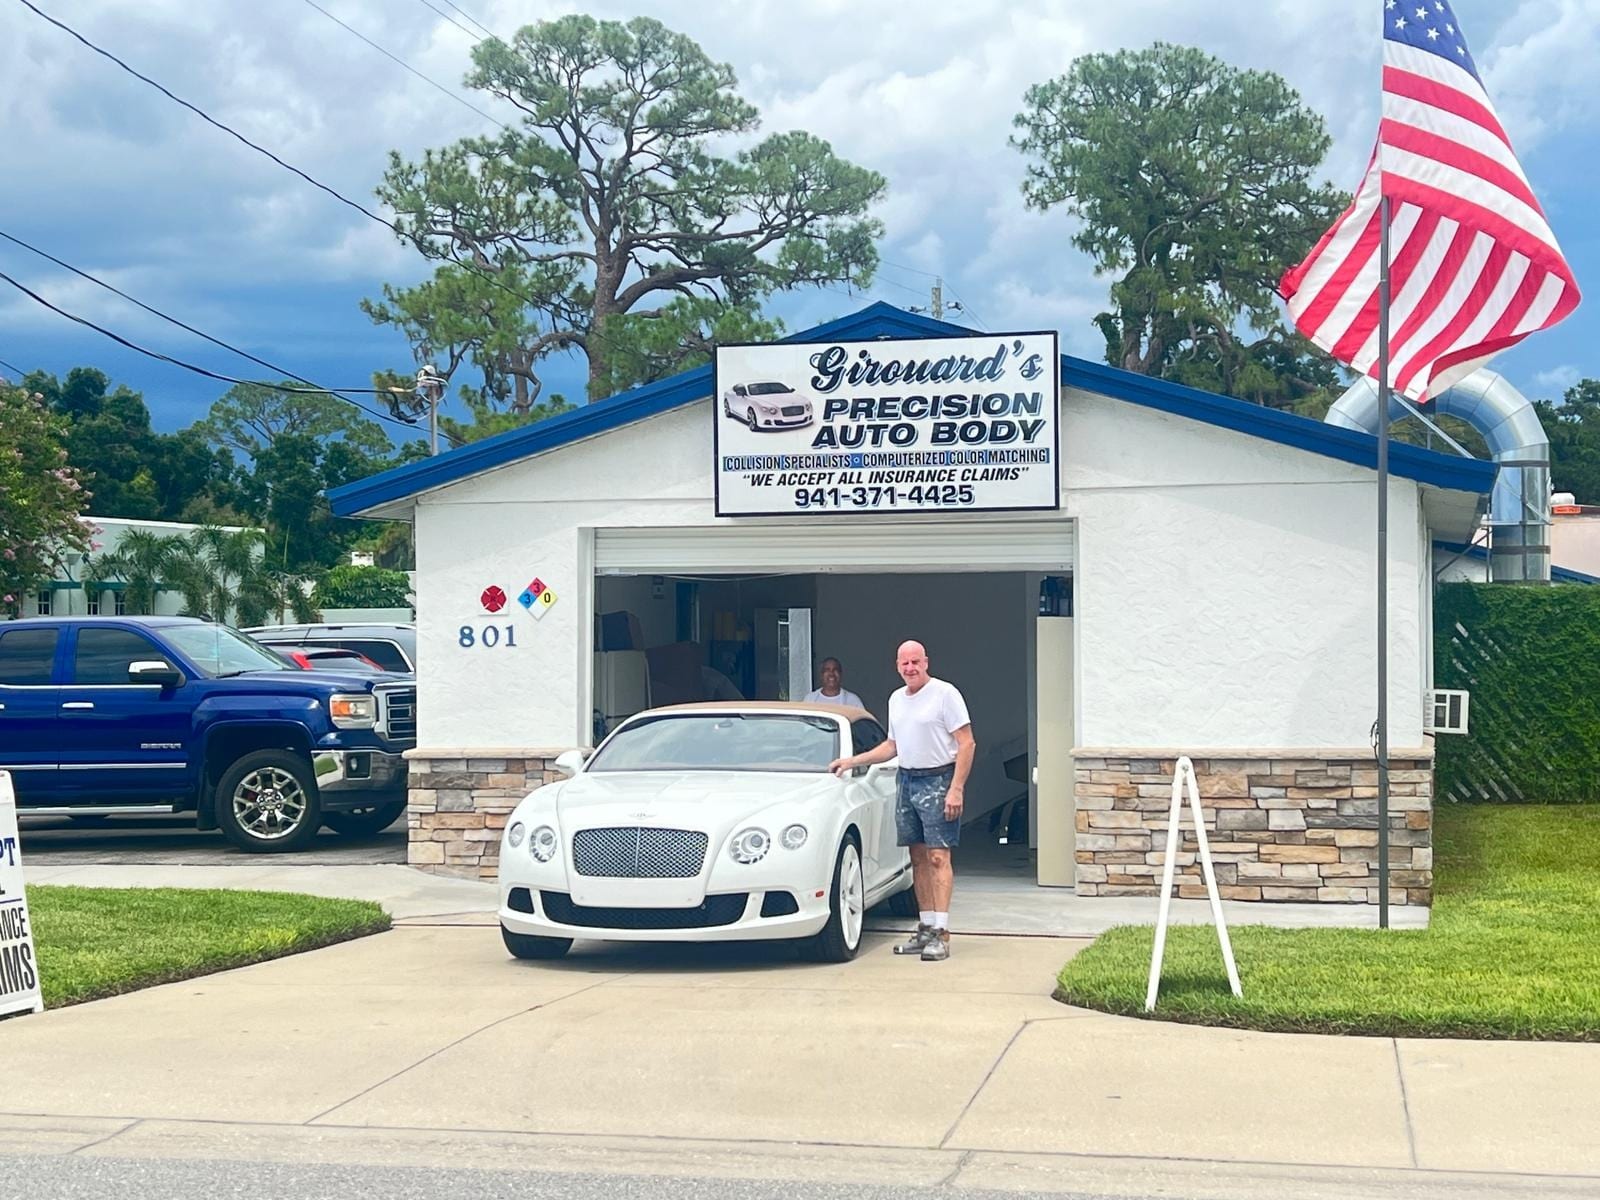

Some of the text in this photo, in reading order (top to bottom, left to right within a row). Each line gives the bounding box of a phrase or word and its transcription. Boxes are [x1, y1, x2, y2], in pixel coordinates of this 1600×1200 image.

[809, 340, 1043, 393] Girouard's
[823, 392, 1043, 421] PRECISION
[811, 418, 1046, 448] AUTO BODY
[727, 448, 1046, 471] COLLISION SPECIALISTS COMPUTERIZED COLOR MATCHING
[777, 471, 835, 486] ACCEPT
[838, 470, 864, 485] ALL
[867, 468, 957, 484] INSURANCE
[795, 484, 975, 509] 941-371-4425
[524, 593, 551, 604] 3 0
[534, 582, 541, 593] 3
[459, 624, 517, 648] 801
